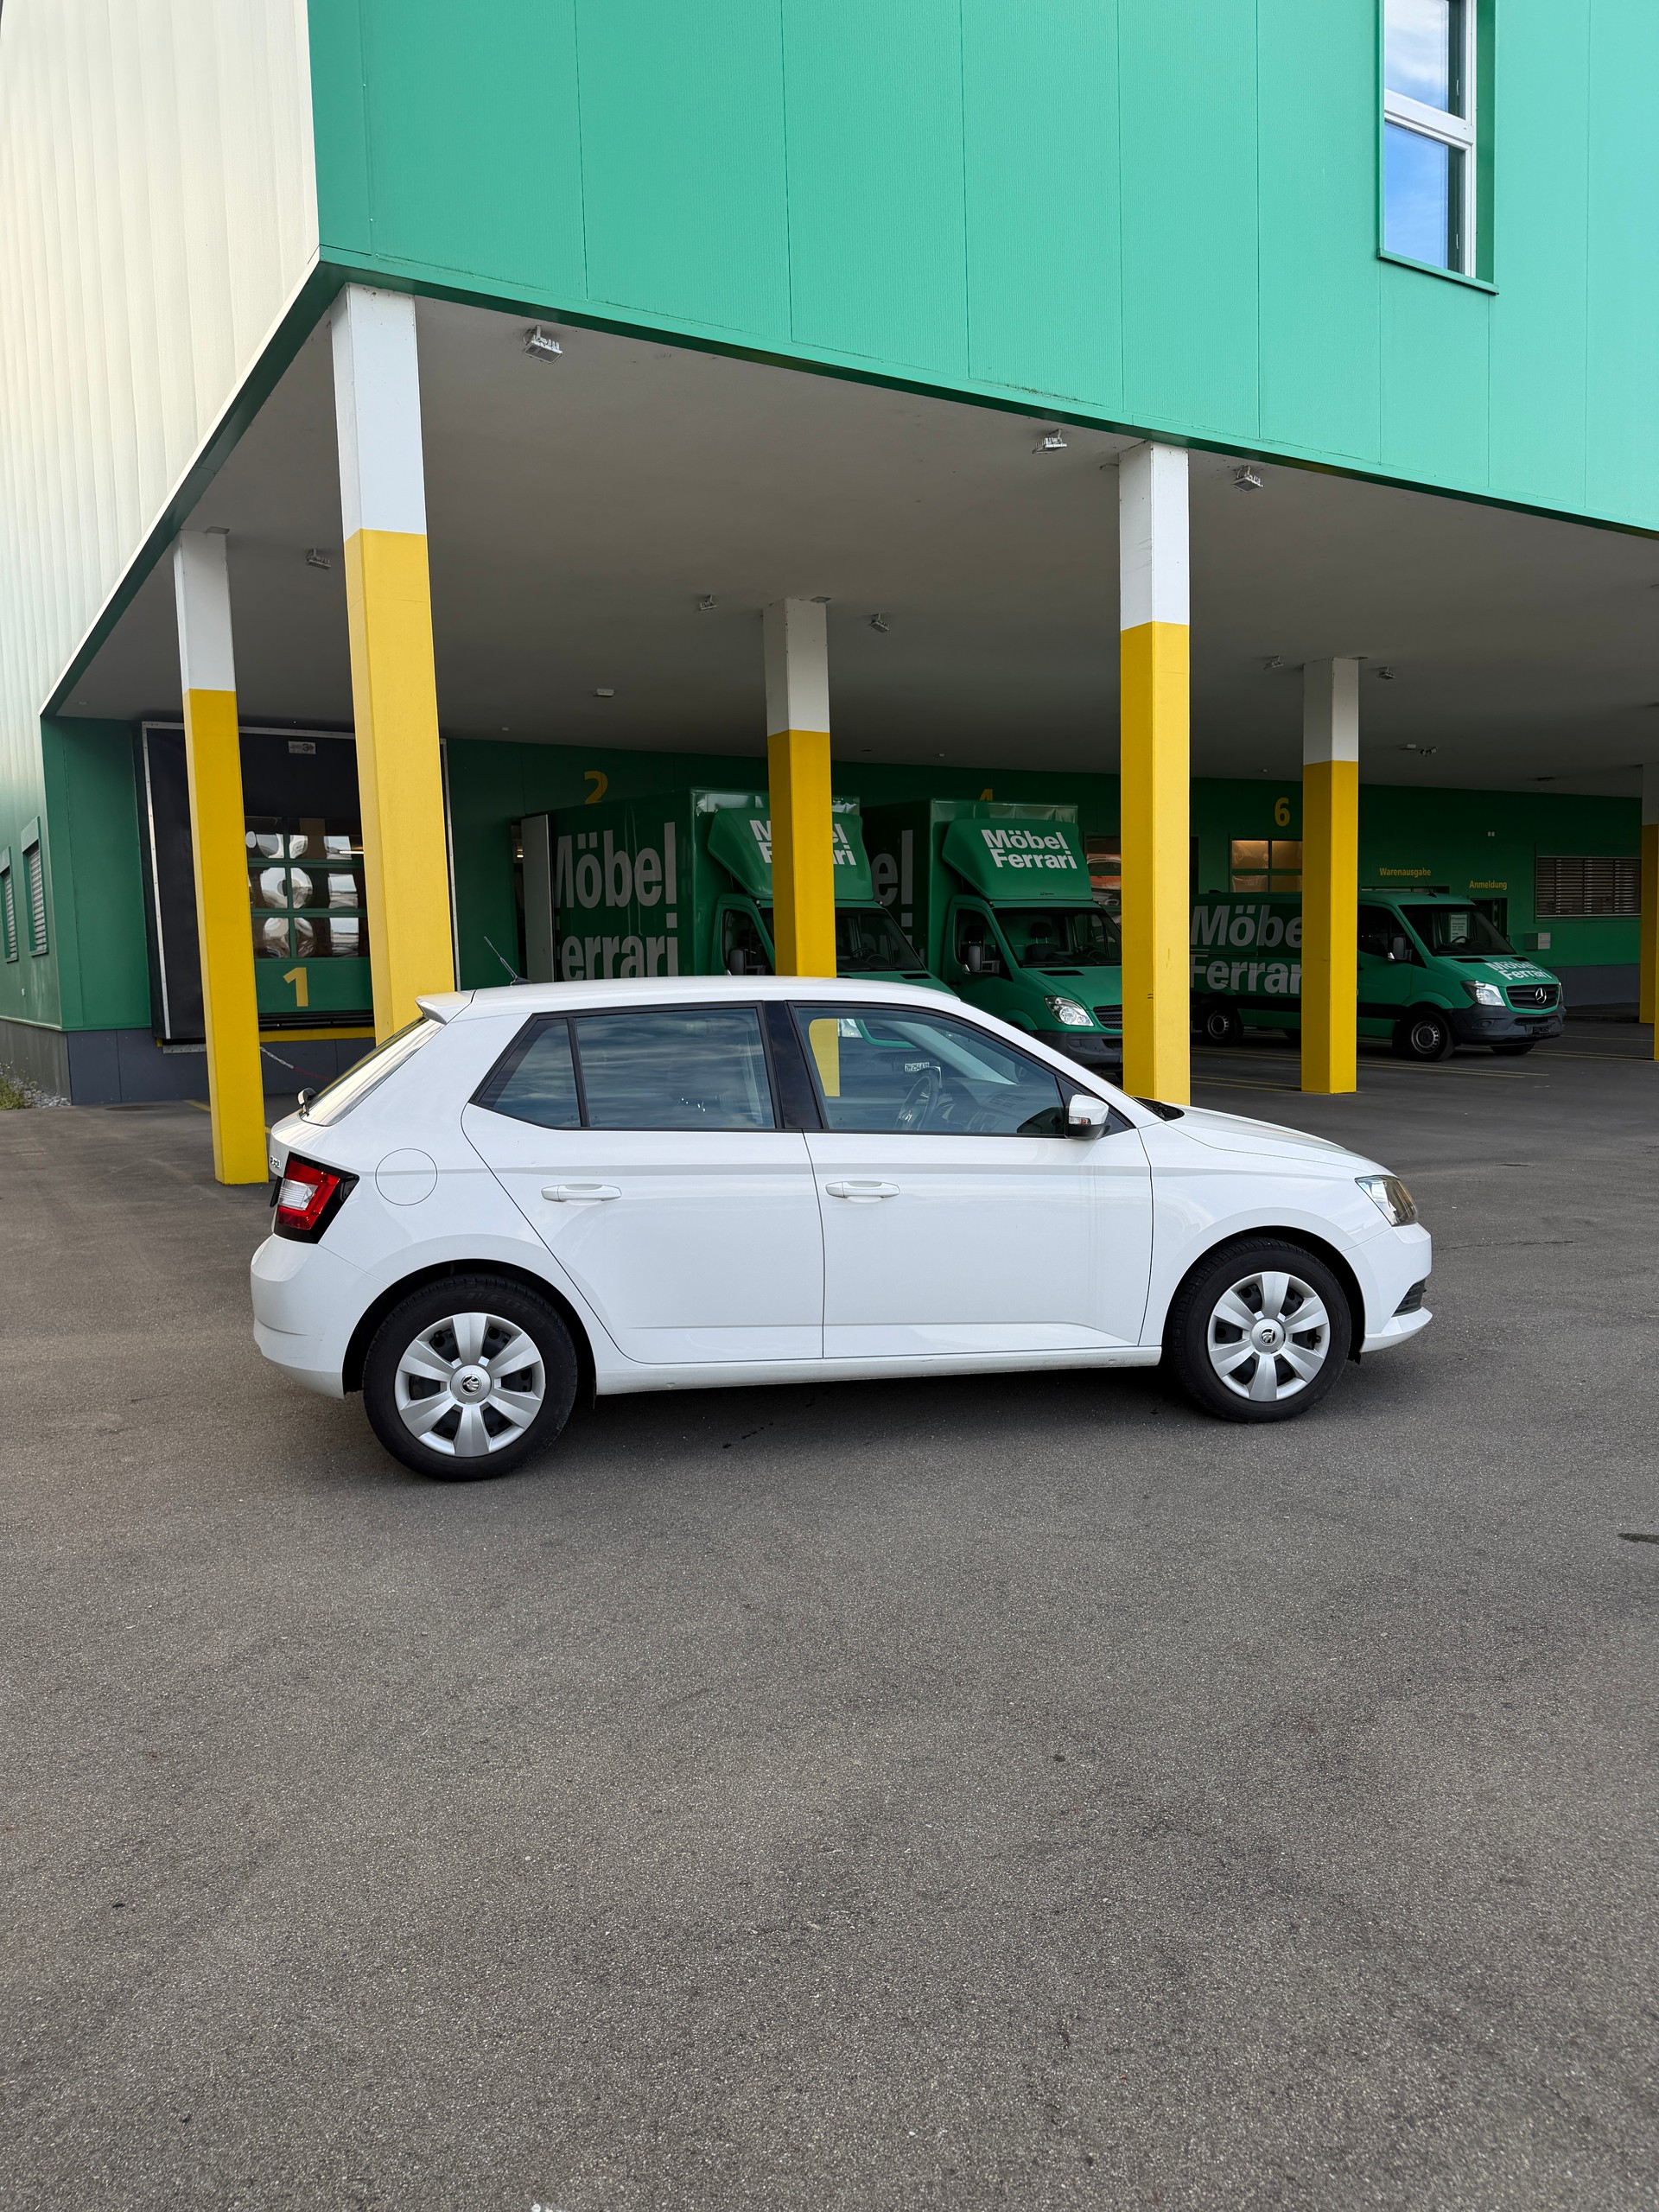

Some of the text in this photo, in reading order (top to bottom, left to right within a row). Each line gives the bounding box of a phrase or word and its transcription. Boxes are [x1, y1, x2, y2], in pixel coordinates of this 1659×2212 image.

[584, 771, 608, 804] 2
[1274, 797, 1291, 827] 6
[981, 829, 1069, 849] Möbel
[989, 849, 1078, 869] Ferrari
[1379, 868, 1432, 878] Warenausgabe
[1469, 880, 1508, 891] Anmeldung
[1190, 905, 1302, 949] Möbe
[1190, 948, 1302, 995] Ferrar
[1484, 961, 1539, 971] Möbel
[1497, 969, 1553, 981] Ferrari
[283, 967, 309, 1007] 1
